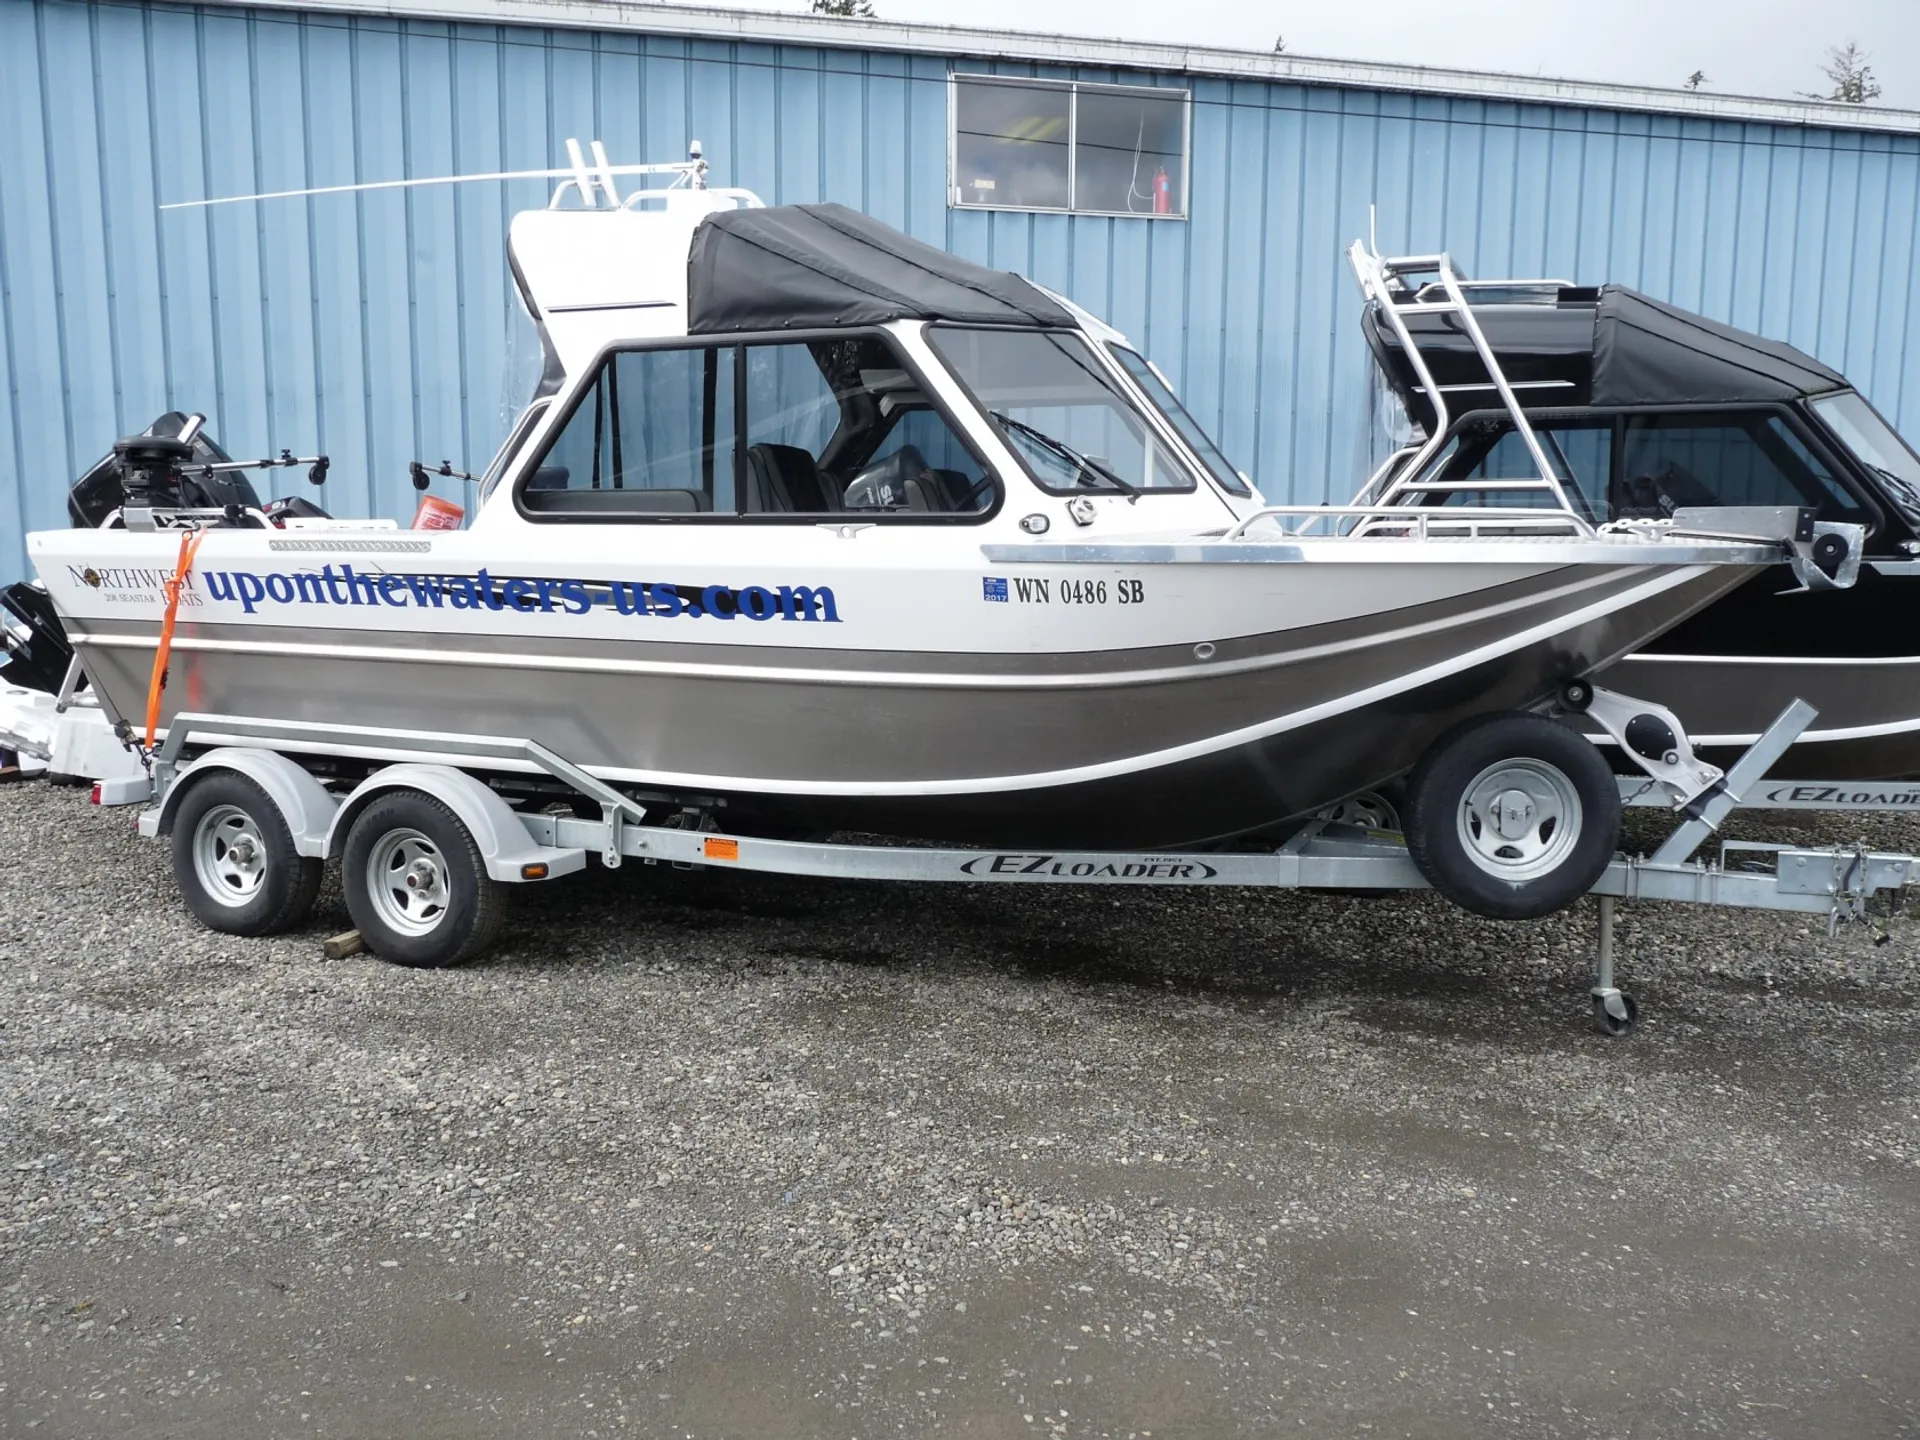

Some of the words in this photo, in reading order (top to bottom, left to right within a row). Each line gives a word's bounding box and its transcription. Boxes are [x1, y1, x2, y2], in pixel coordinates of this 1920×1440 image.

[159, 589, 204, 607] BATS
[202, 563, 844, 623] uponthewaters-us.com
[985, 594, 1007, 602] 2017
[1013, 577, 1050, 603] WN
[1060, 579, 1107, 604] 0486
[1117, 579, 1145, 604] SB
